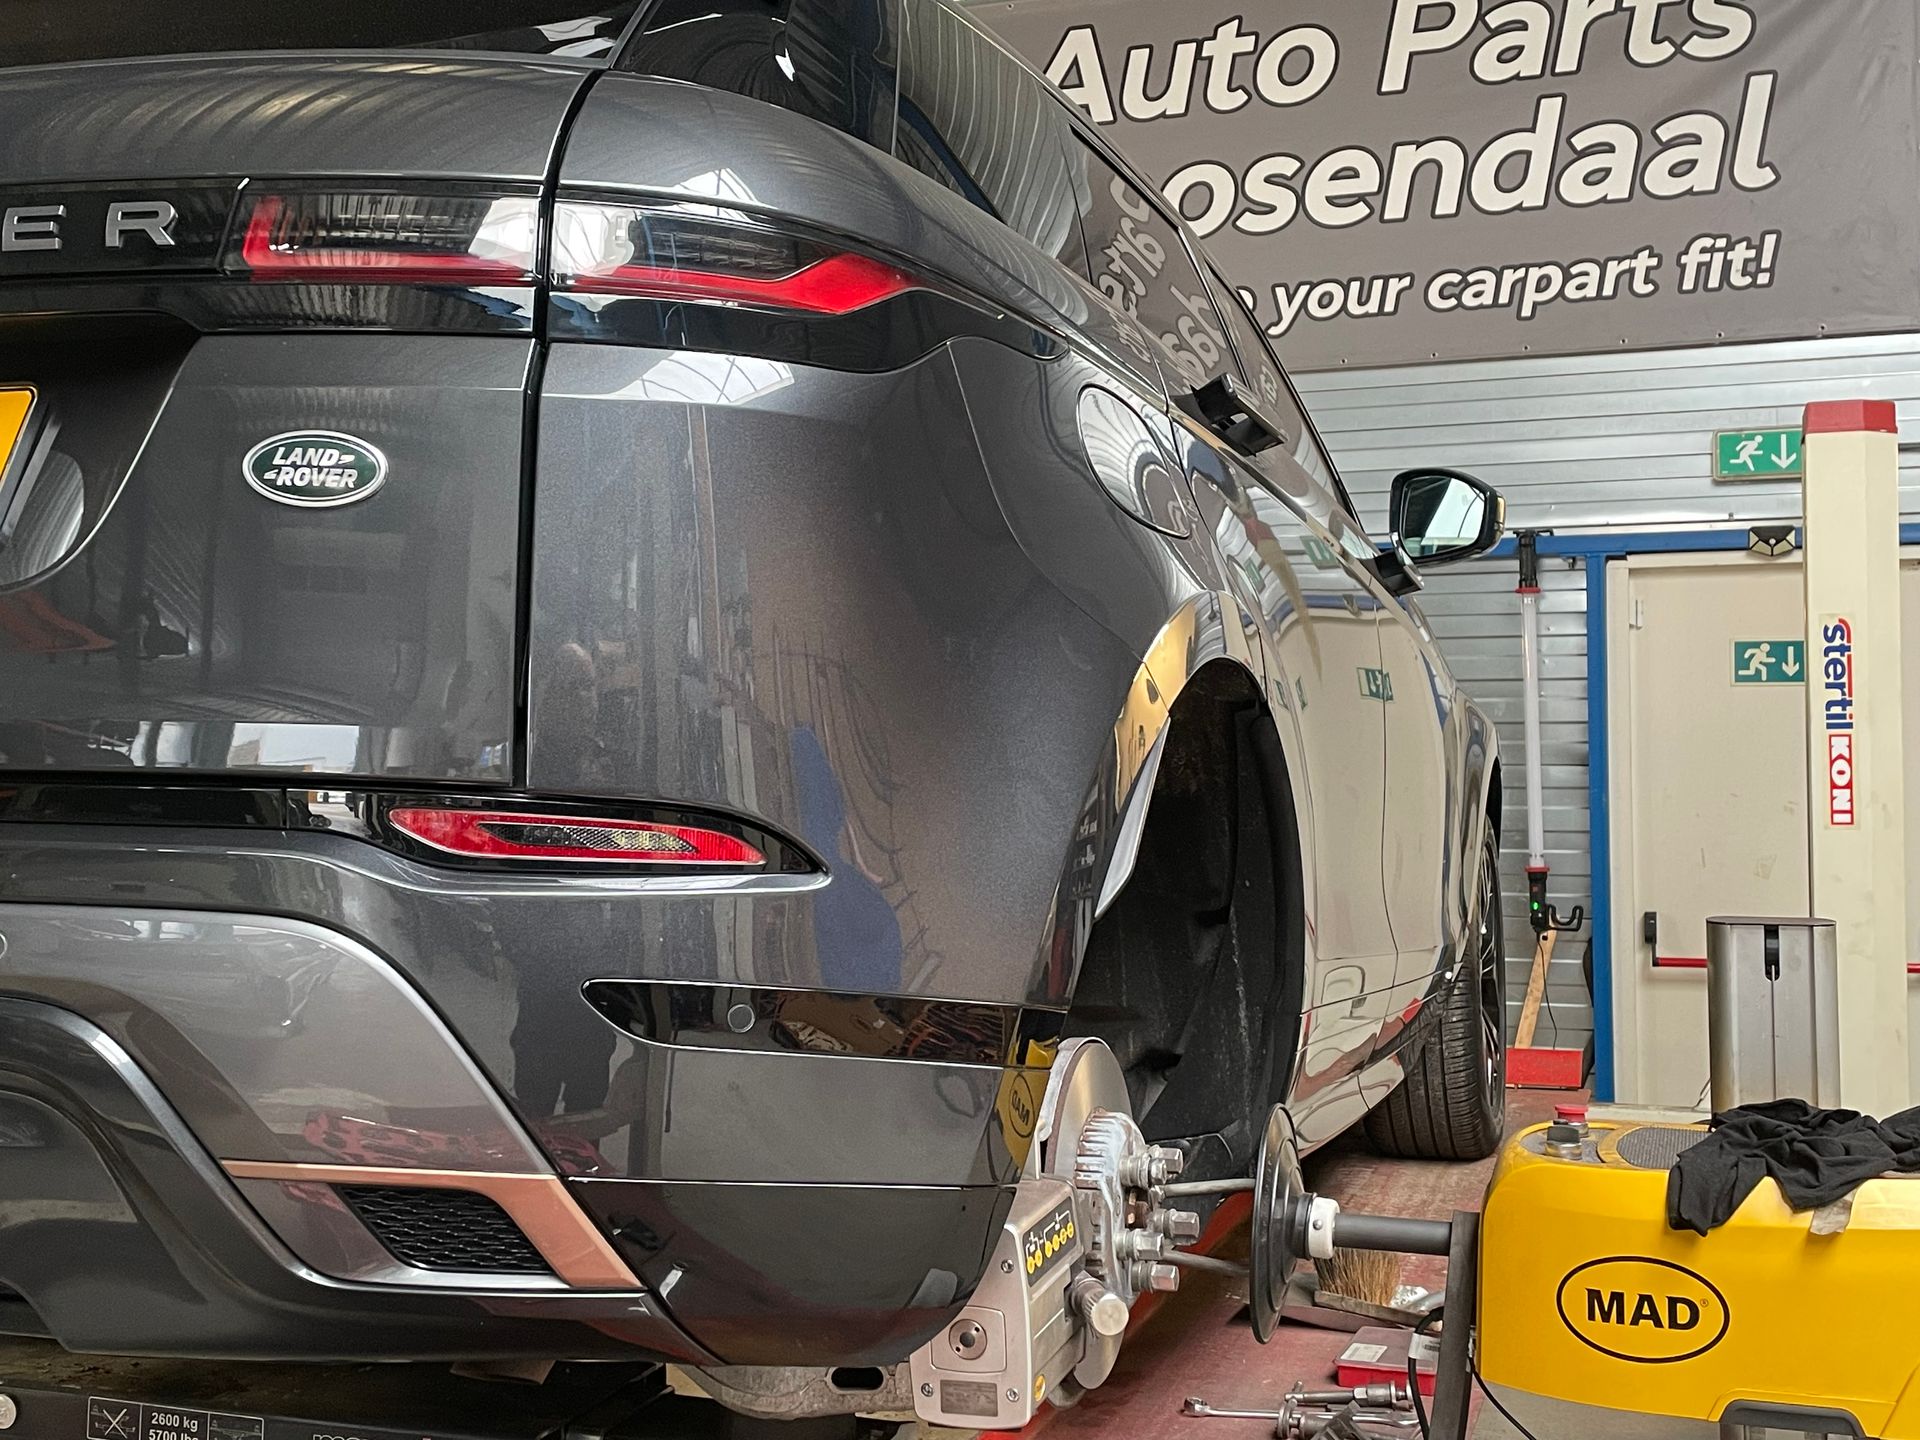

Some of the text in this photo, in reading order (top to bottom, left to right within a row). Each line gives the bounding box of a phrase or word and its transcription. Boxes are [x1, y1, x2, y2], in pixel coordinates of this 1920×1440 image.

[1043, 0, 1754, 122] Auto Parts
[1163, 72, 1780, 238] osendaal
[1266, 273, 1411, 337] your
[1427, 248, 1656, 319] carpart
[1679, 233, 1779, 290] fit!
[272, 447, 341, 466] LAND
[277, 466, 358, 487] ROVER
[1823, 619, 1853, 822] stertil KONI
[1585, 1287, 1701, 1331] MAD
[151, 1412, 198, 1432] 2600 kg
